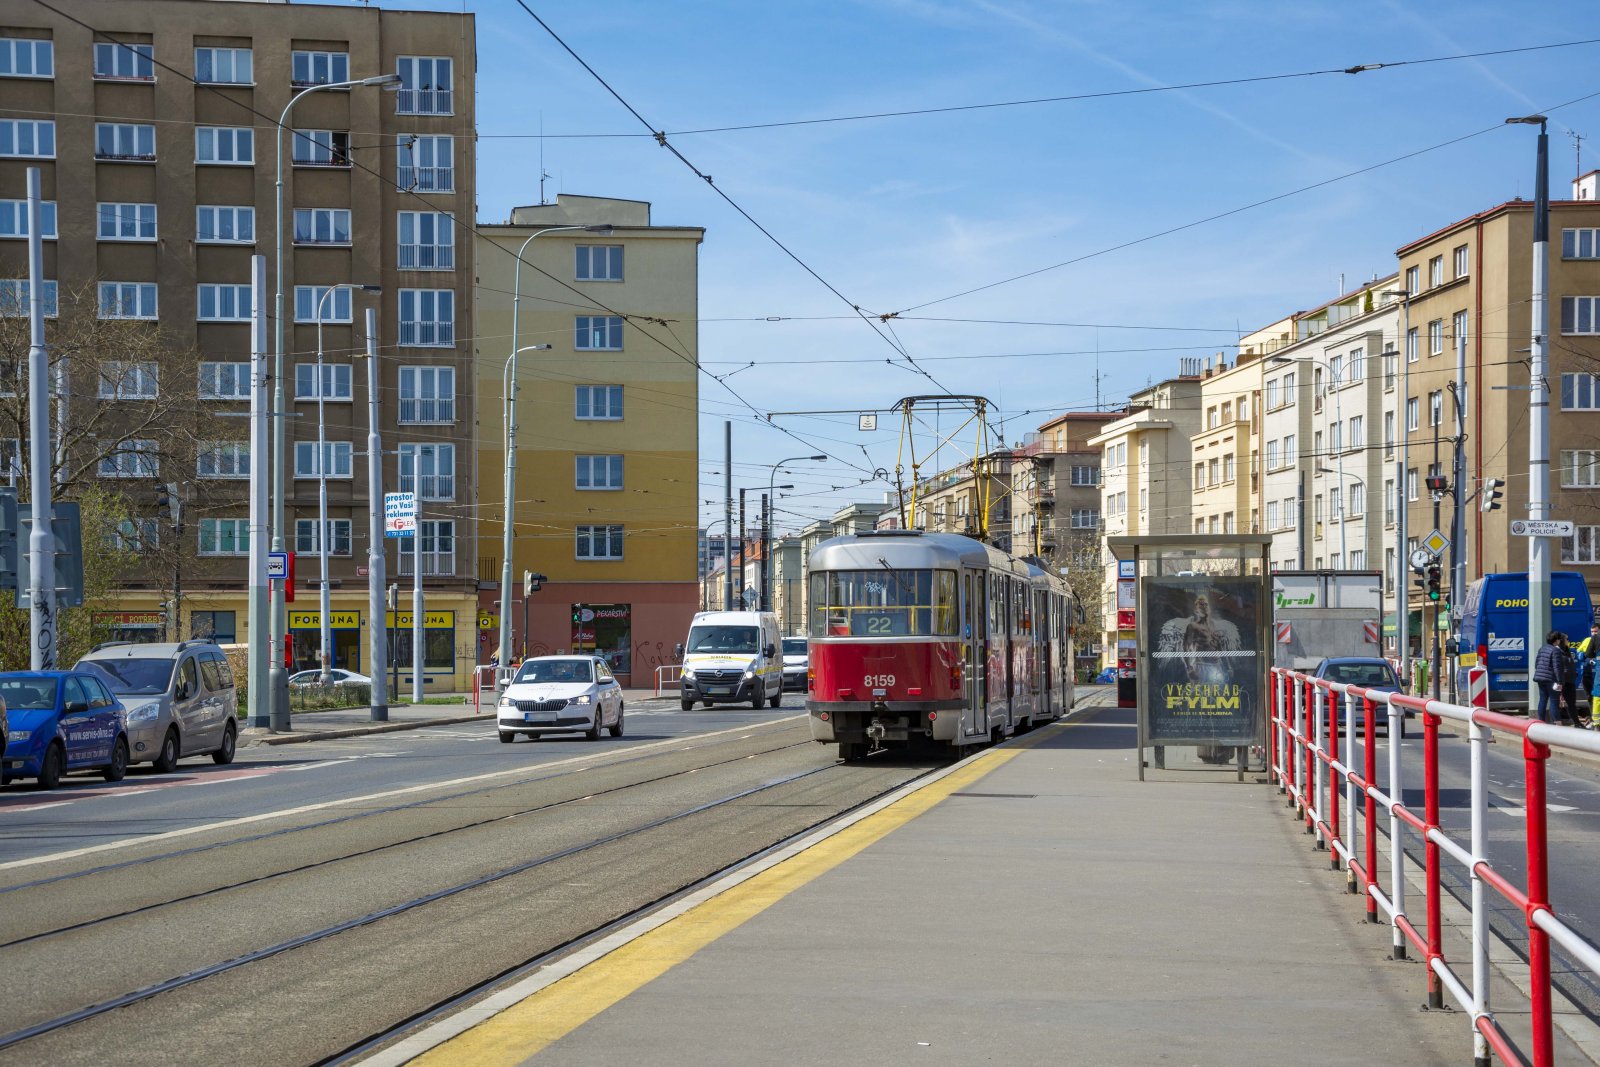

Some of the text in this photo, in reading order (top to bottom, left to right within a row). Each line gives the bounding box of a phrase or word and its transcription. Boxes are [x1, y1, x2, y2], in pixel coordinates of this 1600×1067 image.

[386, 494, 413, 503] prostor
[294, 616, 354, 624] FORUNA
[868, 617, 891, 633] 22
[864, 675, 896, 687] 8159
[1167, 683, 1239, 696] VYŠEHRAD
[1167, 697, 1239, 709] FYLM
